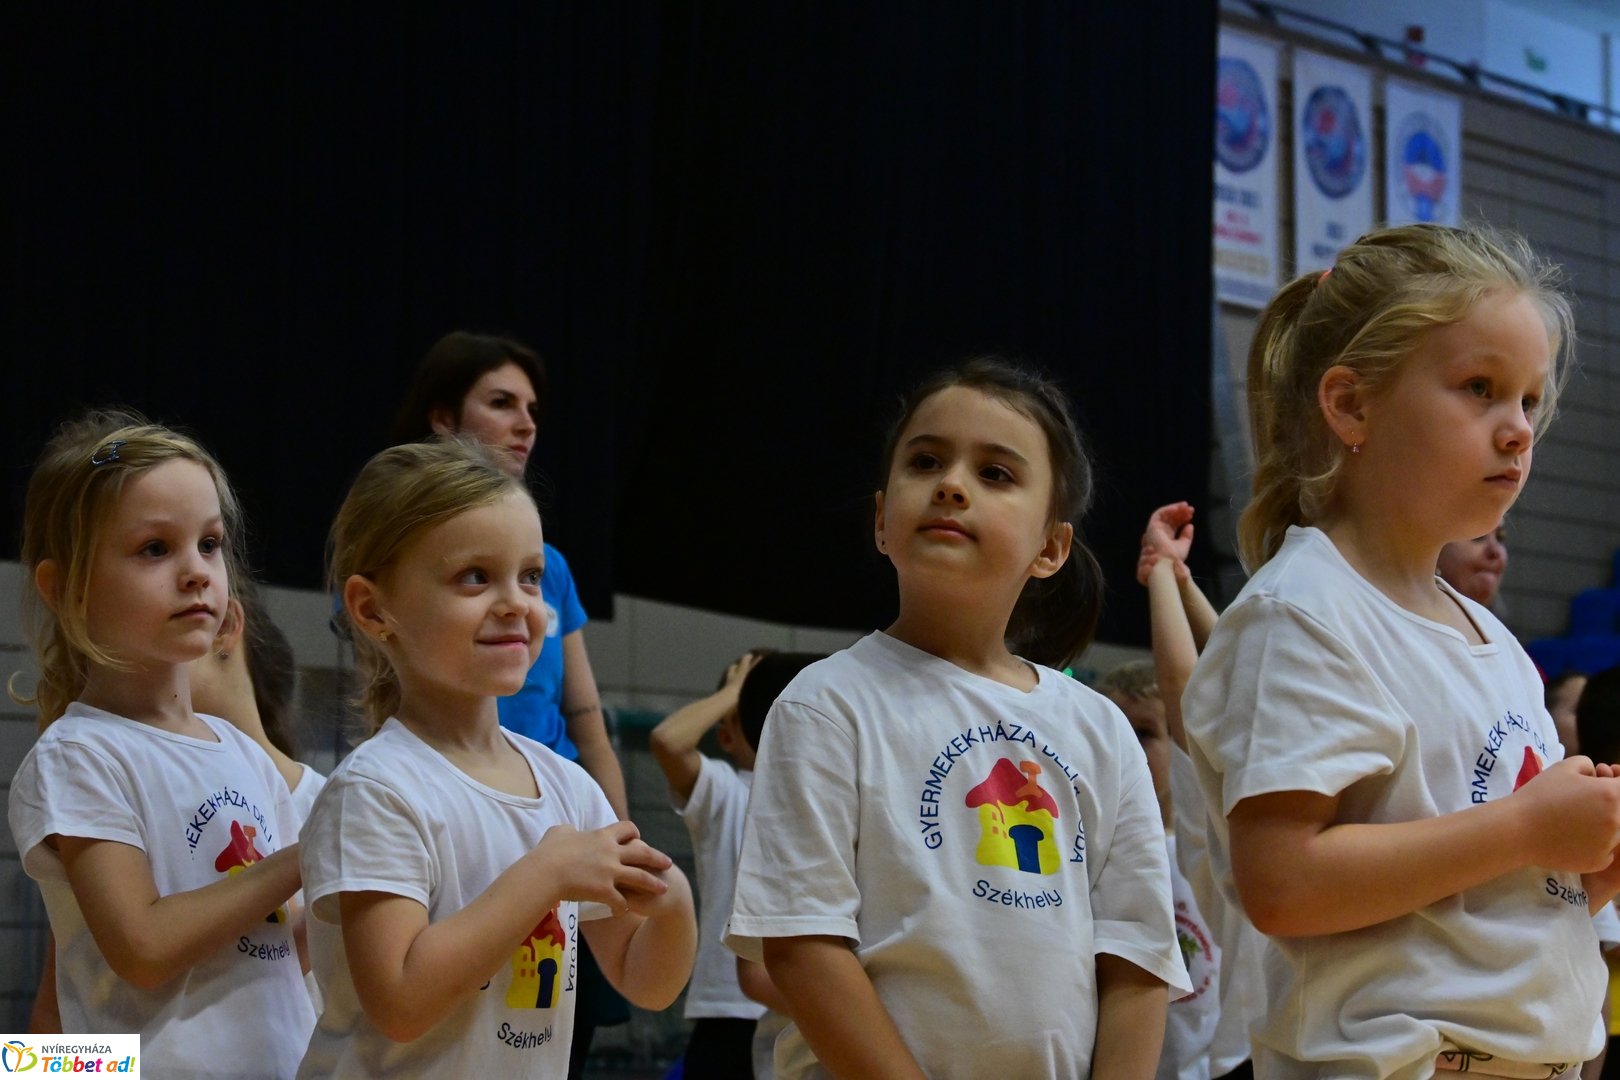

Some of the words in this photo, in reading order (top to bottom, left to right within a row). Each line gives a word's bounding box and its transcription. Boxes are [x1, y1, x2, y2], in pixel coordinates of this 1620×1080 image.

[920, 720, 1036, 849] GYERMEKEKHÁZA
[973, 880, 1063, 909] Székhely
[237, 936, 290, 960] Székhely
[497, 1022, 552, 1049] Székhely
